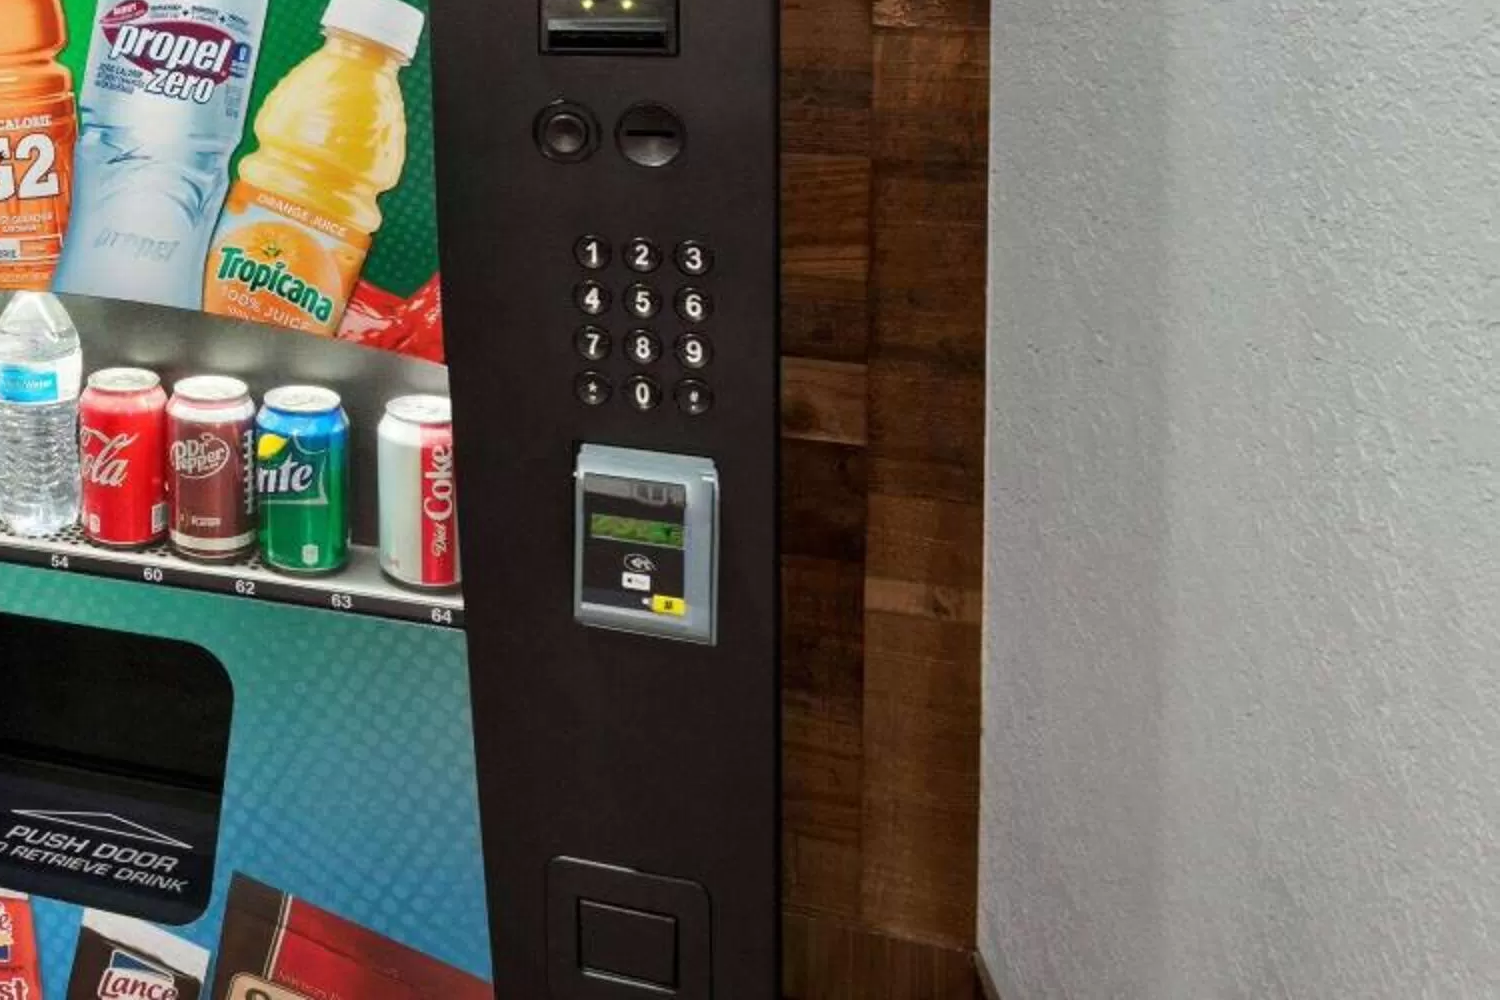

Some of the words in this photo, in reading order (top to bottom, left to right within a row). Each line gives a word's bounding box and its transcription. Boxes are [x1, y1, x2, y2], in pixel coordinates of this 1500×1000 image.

[108, 25, 232, 73] propel
[146, 67, 216, 104] zero
[256, 193, 309, 221] ORANGE
[310, 215, 349, 238] JUICE
[585, 241, 598, 265] 1
[634, 244, 650, 266] 2
[685, 247, 703, 270] 3
[217, 247, 333, 322] Tropicana
[221, 284, 261, 313] 100%
[584, 287, 601, 310] 4
[634, 291, 650, 313] 5
[685, 294, 703, 317] 6
[586, 333, 600, 355] 7
[634, 336, 650, 359] 8
[685, 340, 703, 363] 9
[634, 382, 650, 406] 0
[81, 432, 141, 488] ola
[172, 441, 227, 474] Pepper
[423, 444, 454, 523] Coke
[51, 554, 69, 568] 54
[143, 567, 163, 583] 60
[235, 580, 256, 595] 62
[331, 594, 352, 609] 63
[431, 607, 453, 624] 64
[5, 825, 90, 853] PUSH
[92, 843, 179, 873] DOOR
[10, 845, 113, 876] RETRIEVE
[113, 867, 189, 893] DRINK
[100, 971, 177, 1000] Lance
